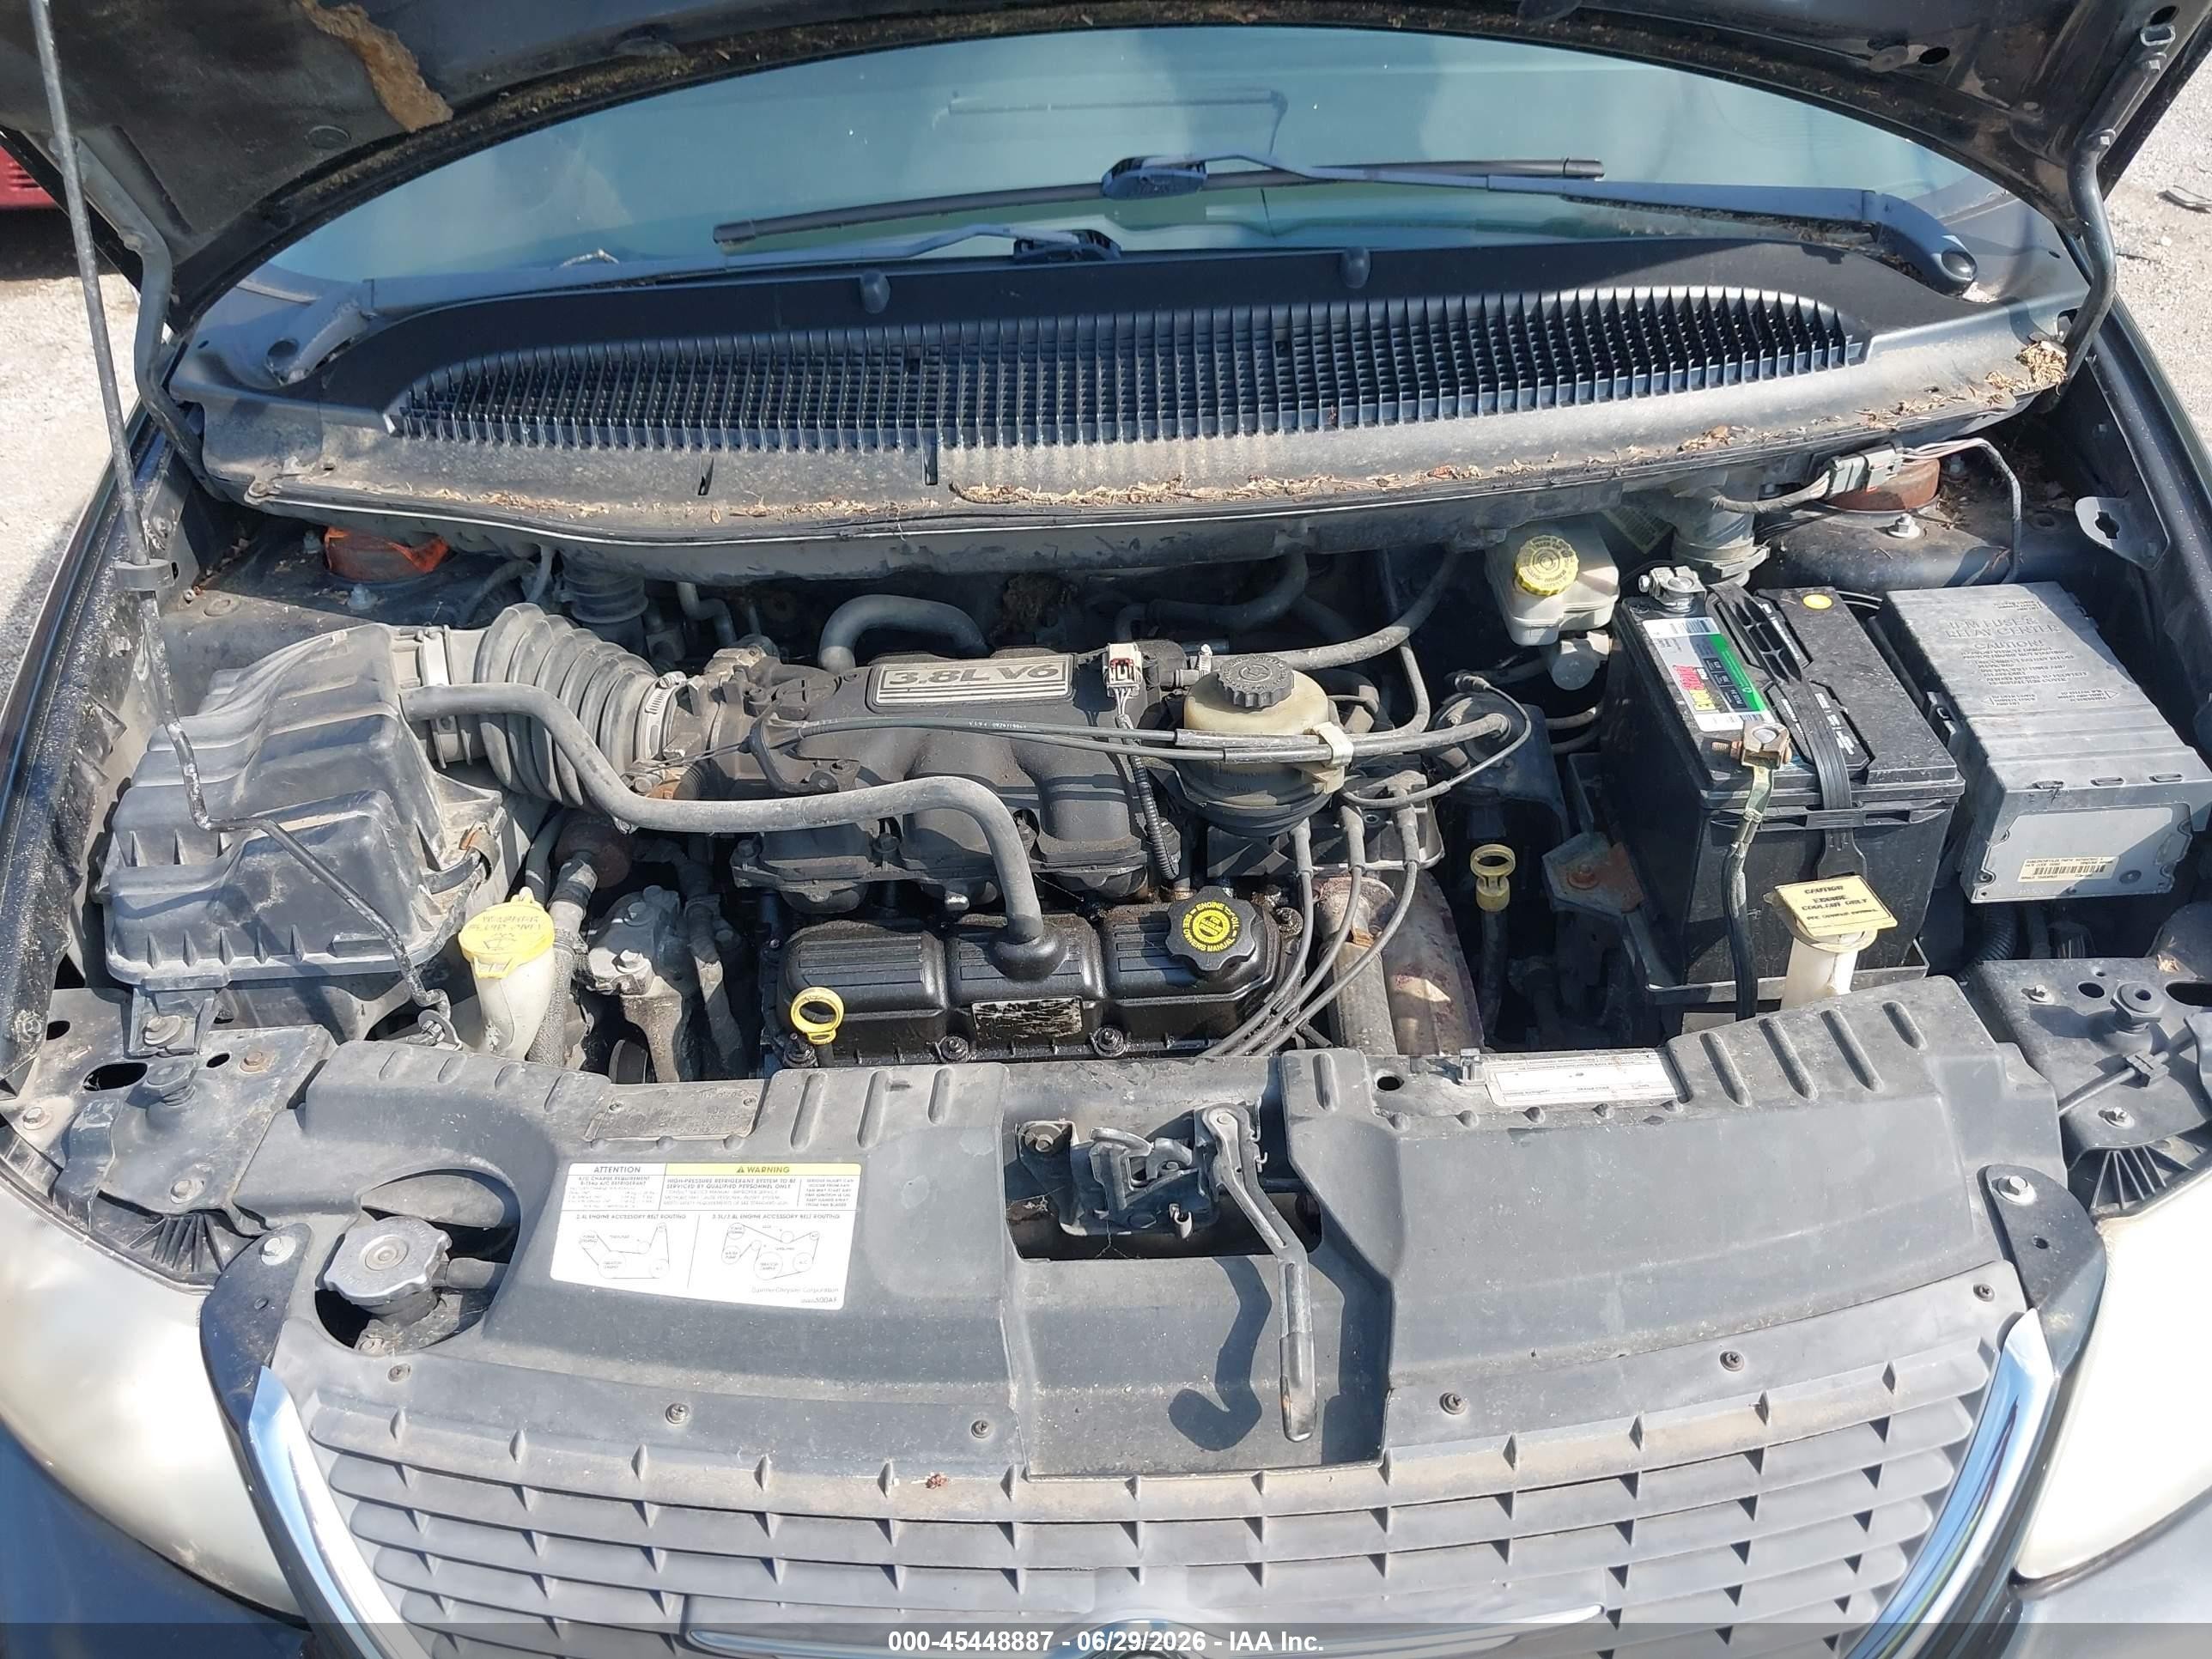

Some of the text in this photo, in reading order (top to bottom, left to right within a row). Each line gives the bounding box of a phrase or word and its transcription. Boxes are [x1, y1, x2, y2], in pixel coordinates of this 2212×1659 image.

[889, 664, 1059, 684] 3.8L V6
[1183, 914, 1192, 928] SEE
[1196, 902, 1239, 929] ENGINE OIL
[1183, 928, 1206, 951] OWNERS
[1207, 938, 1235, 951] MANUAL
